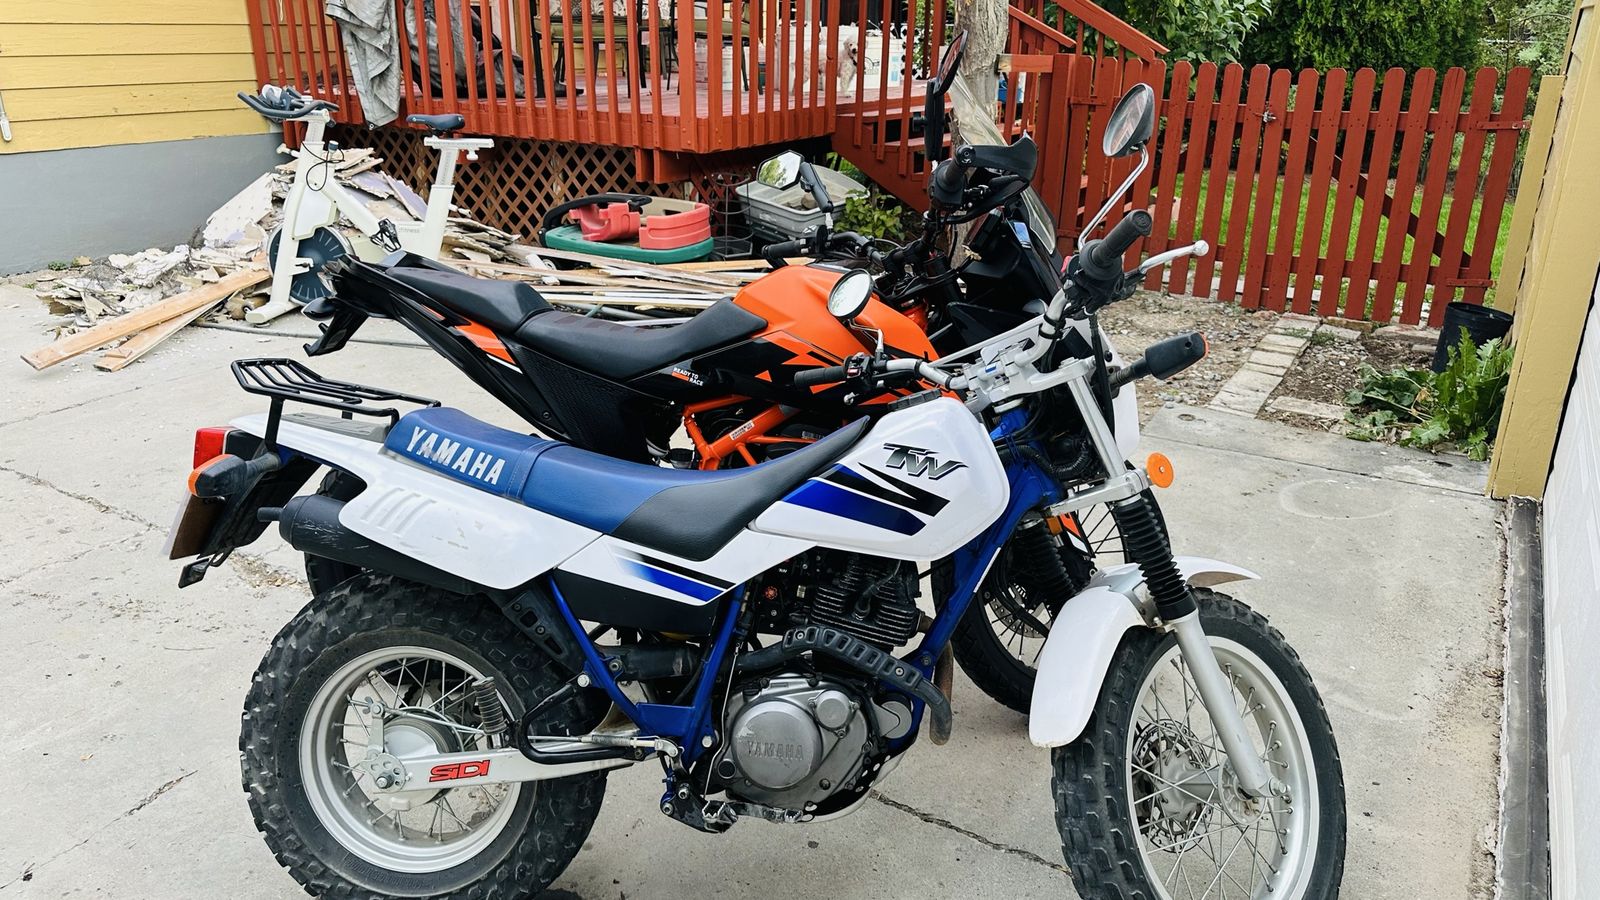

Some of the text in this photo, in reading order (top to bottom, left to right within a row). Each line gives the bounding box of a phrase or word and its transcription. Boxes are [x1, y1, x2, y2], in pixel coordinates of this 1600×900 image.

[673, 367, 699, 380] READY TO
[689, 377, 704, 387] RACE
[406, 426, 506, 485] YAMAHA
[883, 443, 968, 480] TW
[747, 740, 804, 760] YAMAHA
